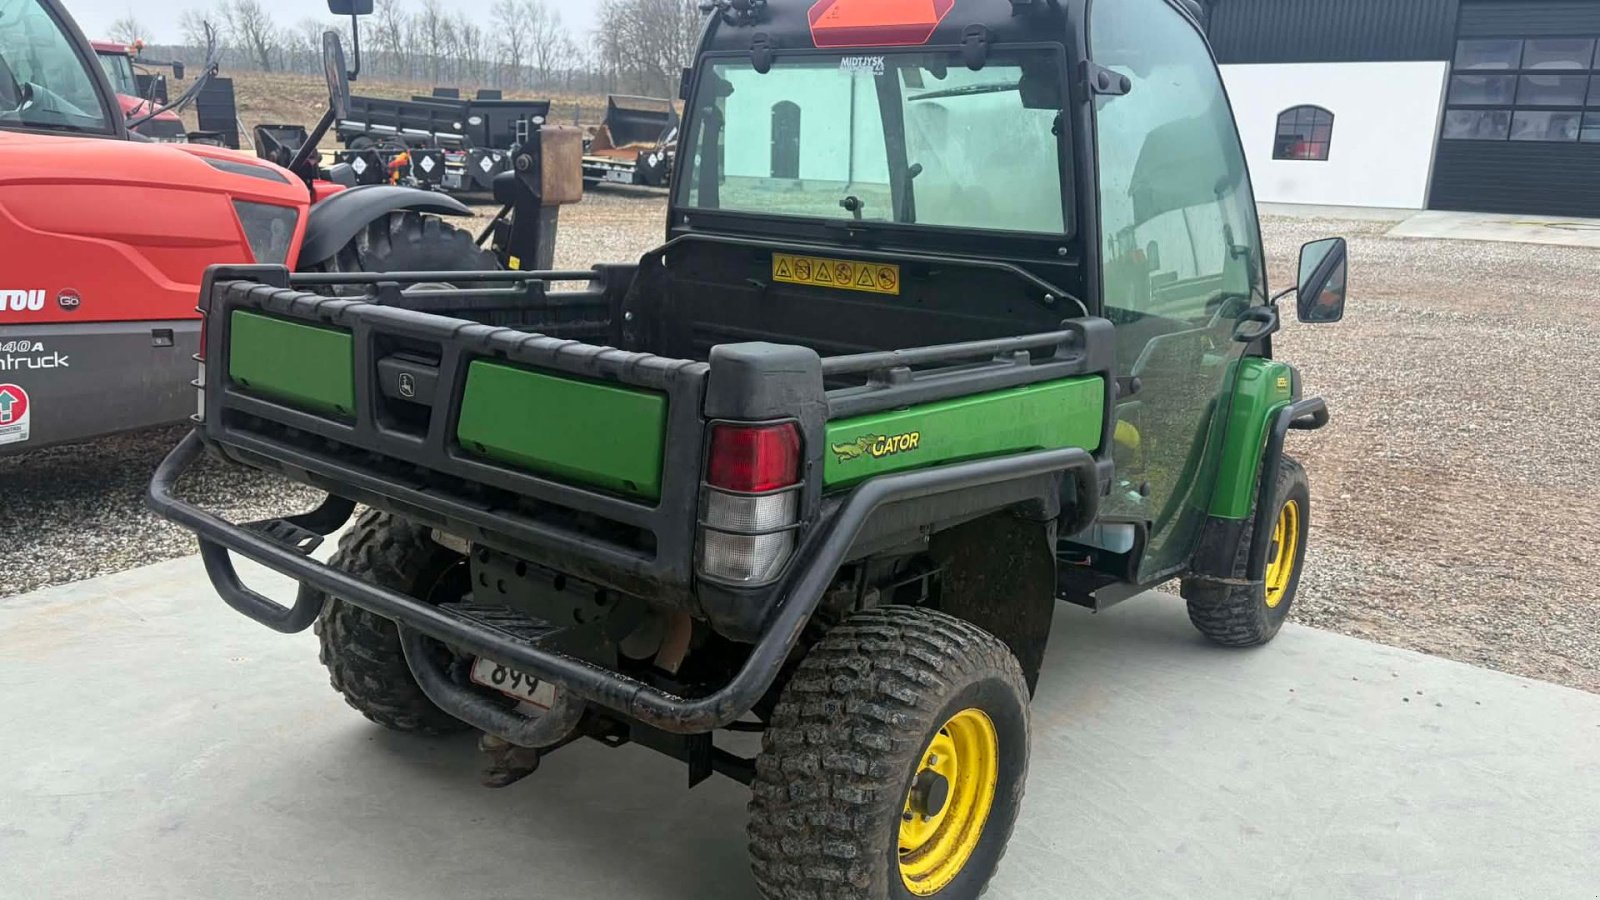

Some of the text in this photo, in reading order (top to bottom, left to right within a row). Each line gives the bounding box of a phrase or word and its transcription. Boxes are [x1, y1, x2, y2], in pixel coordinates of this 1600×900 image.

[841, 56, 884, 66] MIDTJYSK
[0, 340, 44, 353] 40A
[872, 431, 919, 456] GATOR
